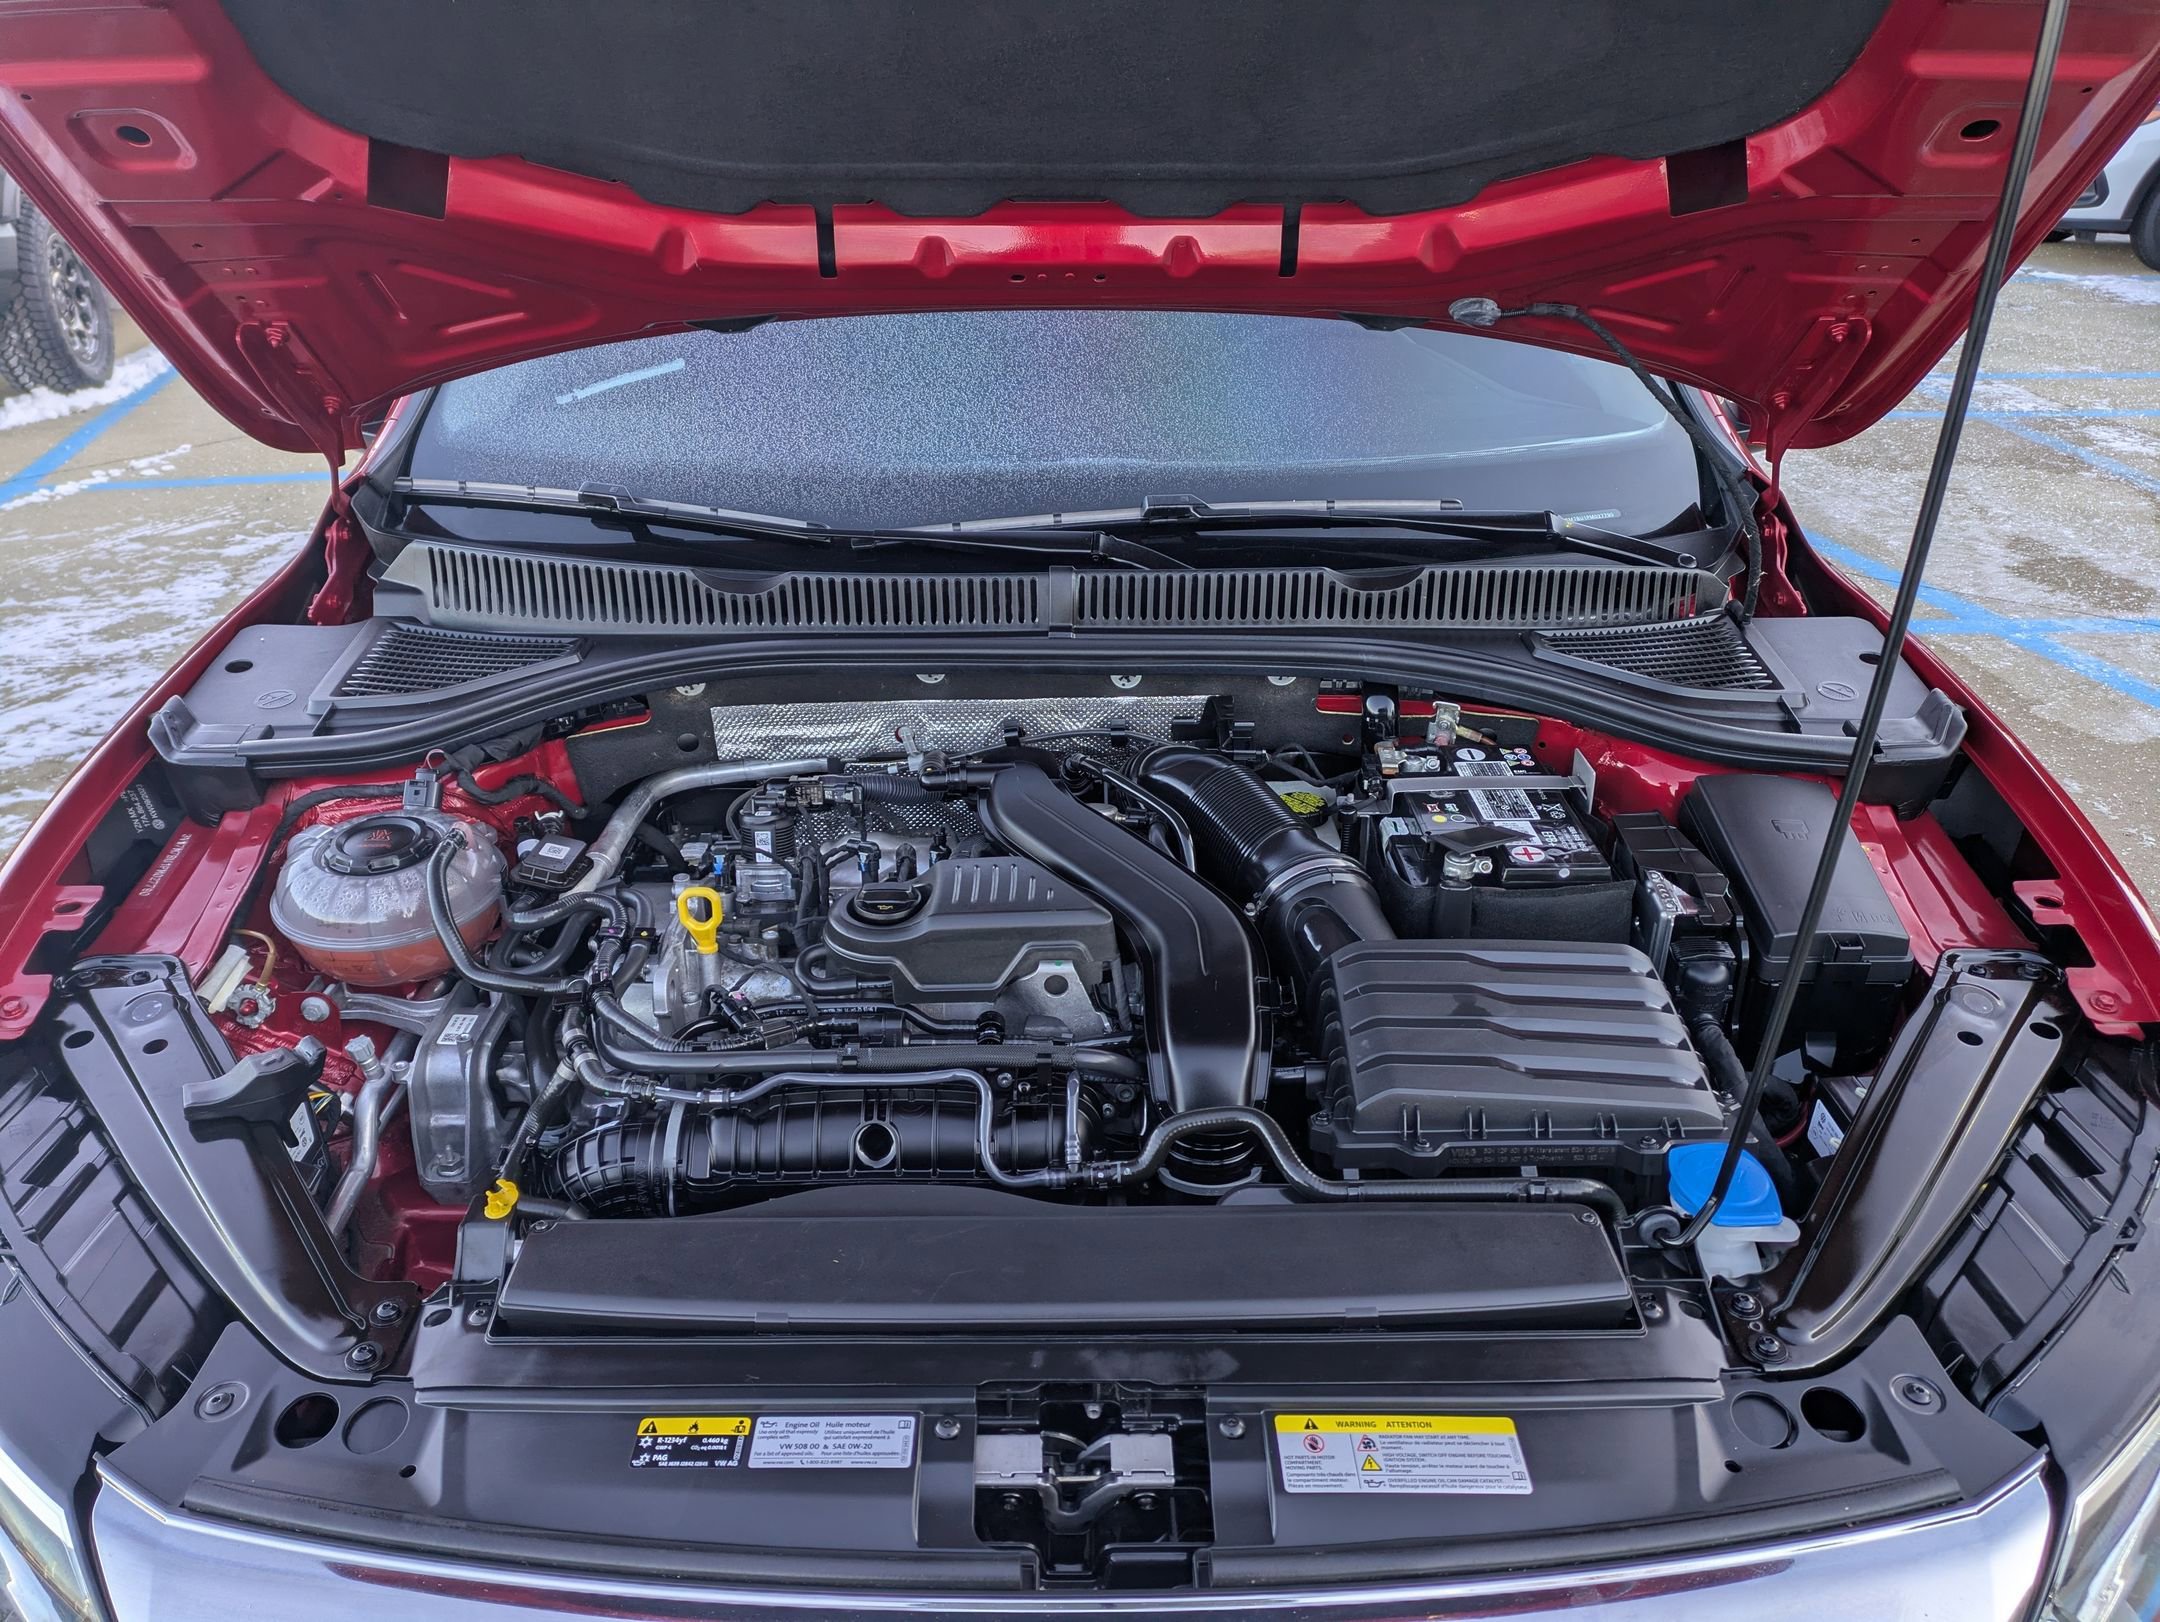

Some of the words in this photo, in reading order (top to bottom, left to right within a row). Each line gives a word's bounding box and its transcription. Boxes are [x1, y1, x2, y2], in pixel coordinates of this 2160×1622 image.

[785, 1422, 808, 1430] Engine
[656, 1436, 688, 1445] R-1234yf
[721, 1437, 729, 1446] kg
